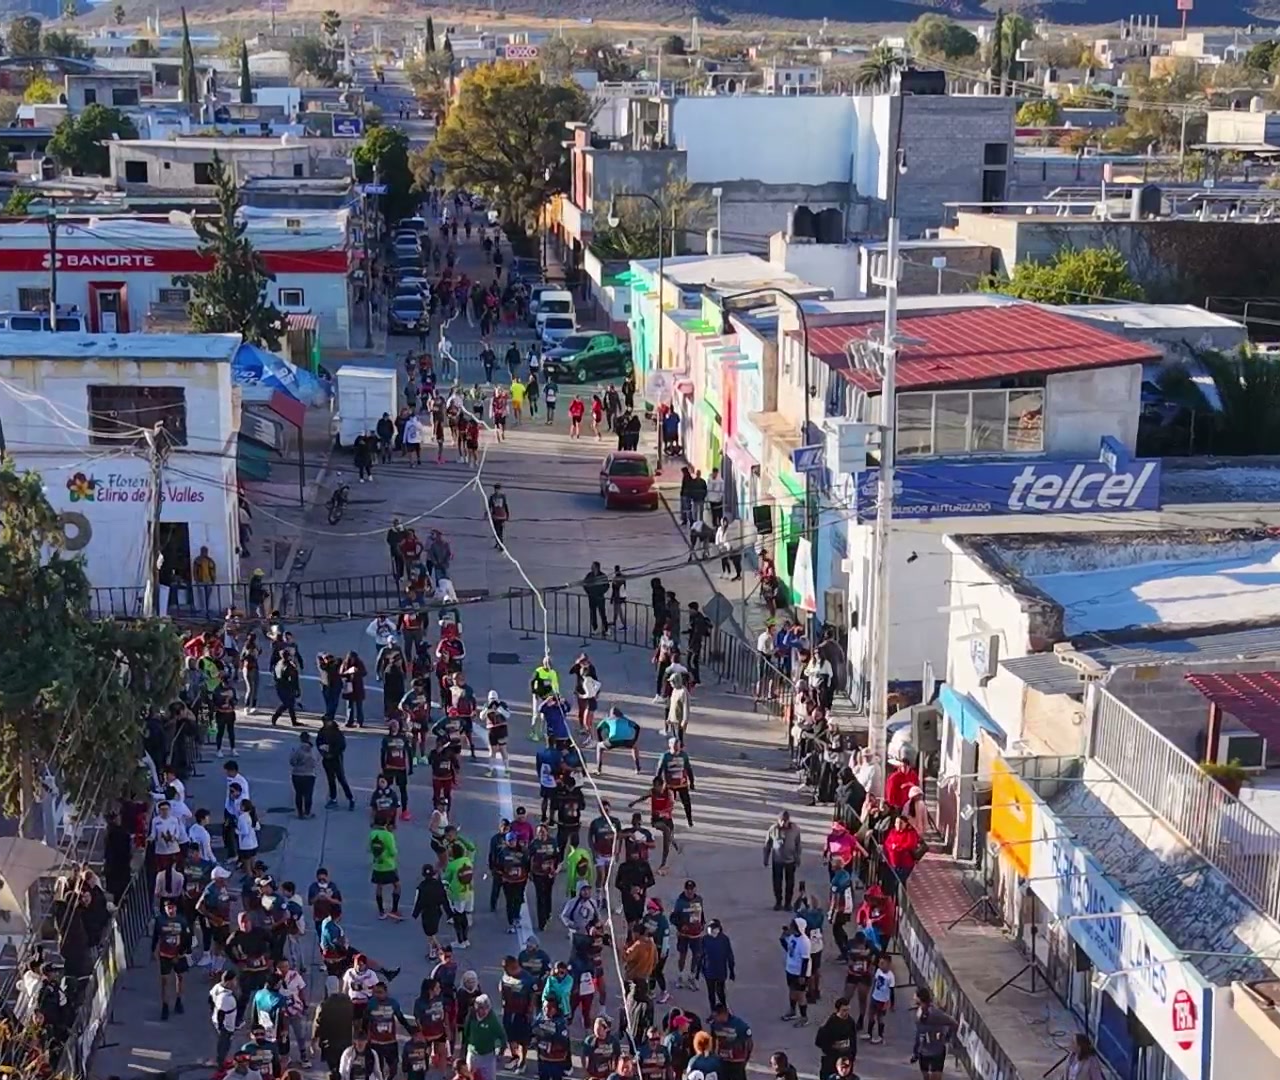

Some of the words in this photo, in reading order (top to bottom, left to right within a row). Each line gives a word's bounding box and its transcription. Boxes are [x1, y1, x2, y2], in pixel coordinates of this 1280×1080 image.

[510, 46, 538, 57] OXXO
[66, 254, 156, 267] BANORTE
[1007, 463, 1157, 511] telcel
[131, 488, 146, 502] de
[169, 487, 205, 503] Valles
[930, 502, 992, 513] AUTORIZADO
